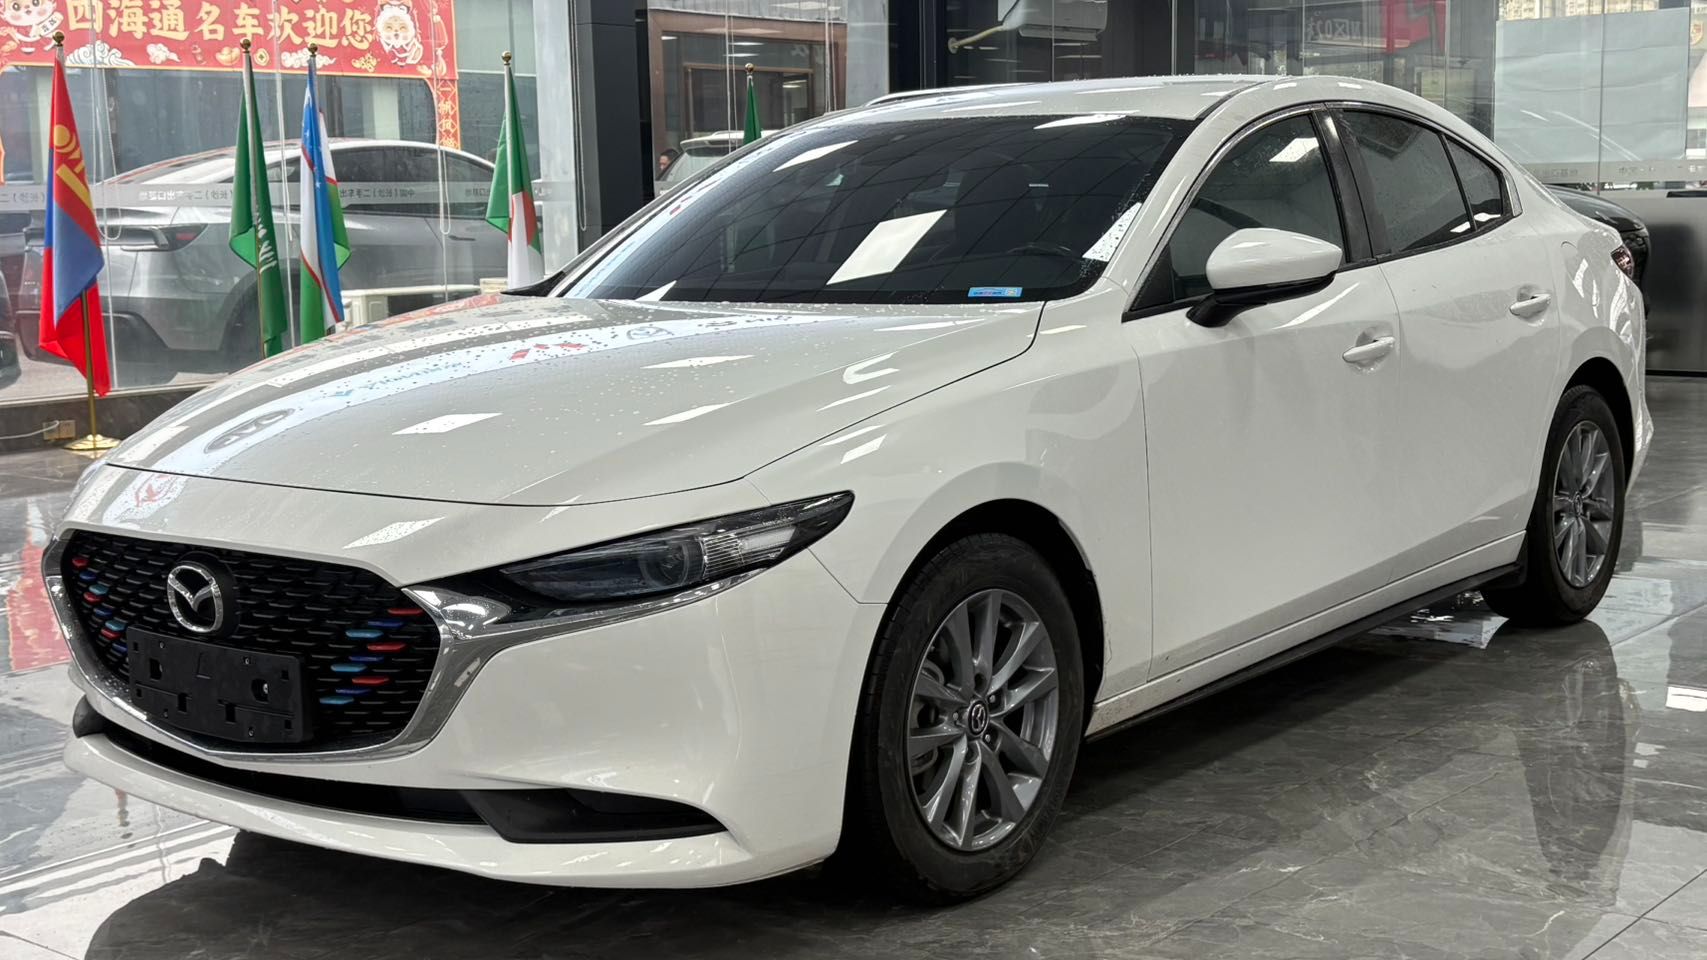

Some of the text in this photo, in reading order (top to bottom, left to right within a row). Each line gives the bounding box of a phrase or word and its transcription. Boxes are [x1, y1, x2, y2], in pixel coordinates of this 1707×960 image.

[66, 0, 373, 50] 四海通名车欢迎您
